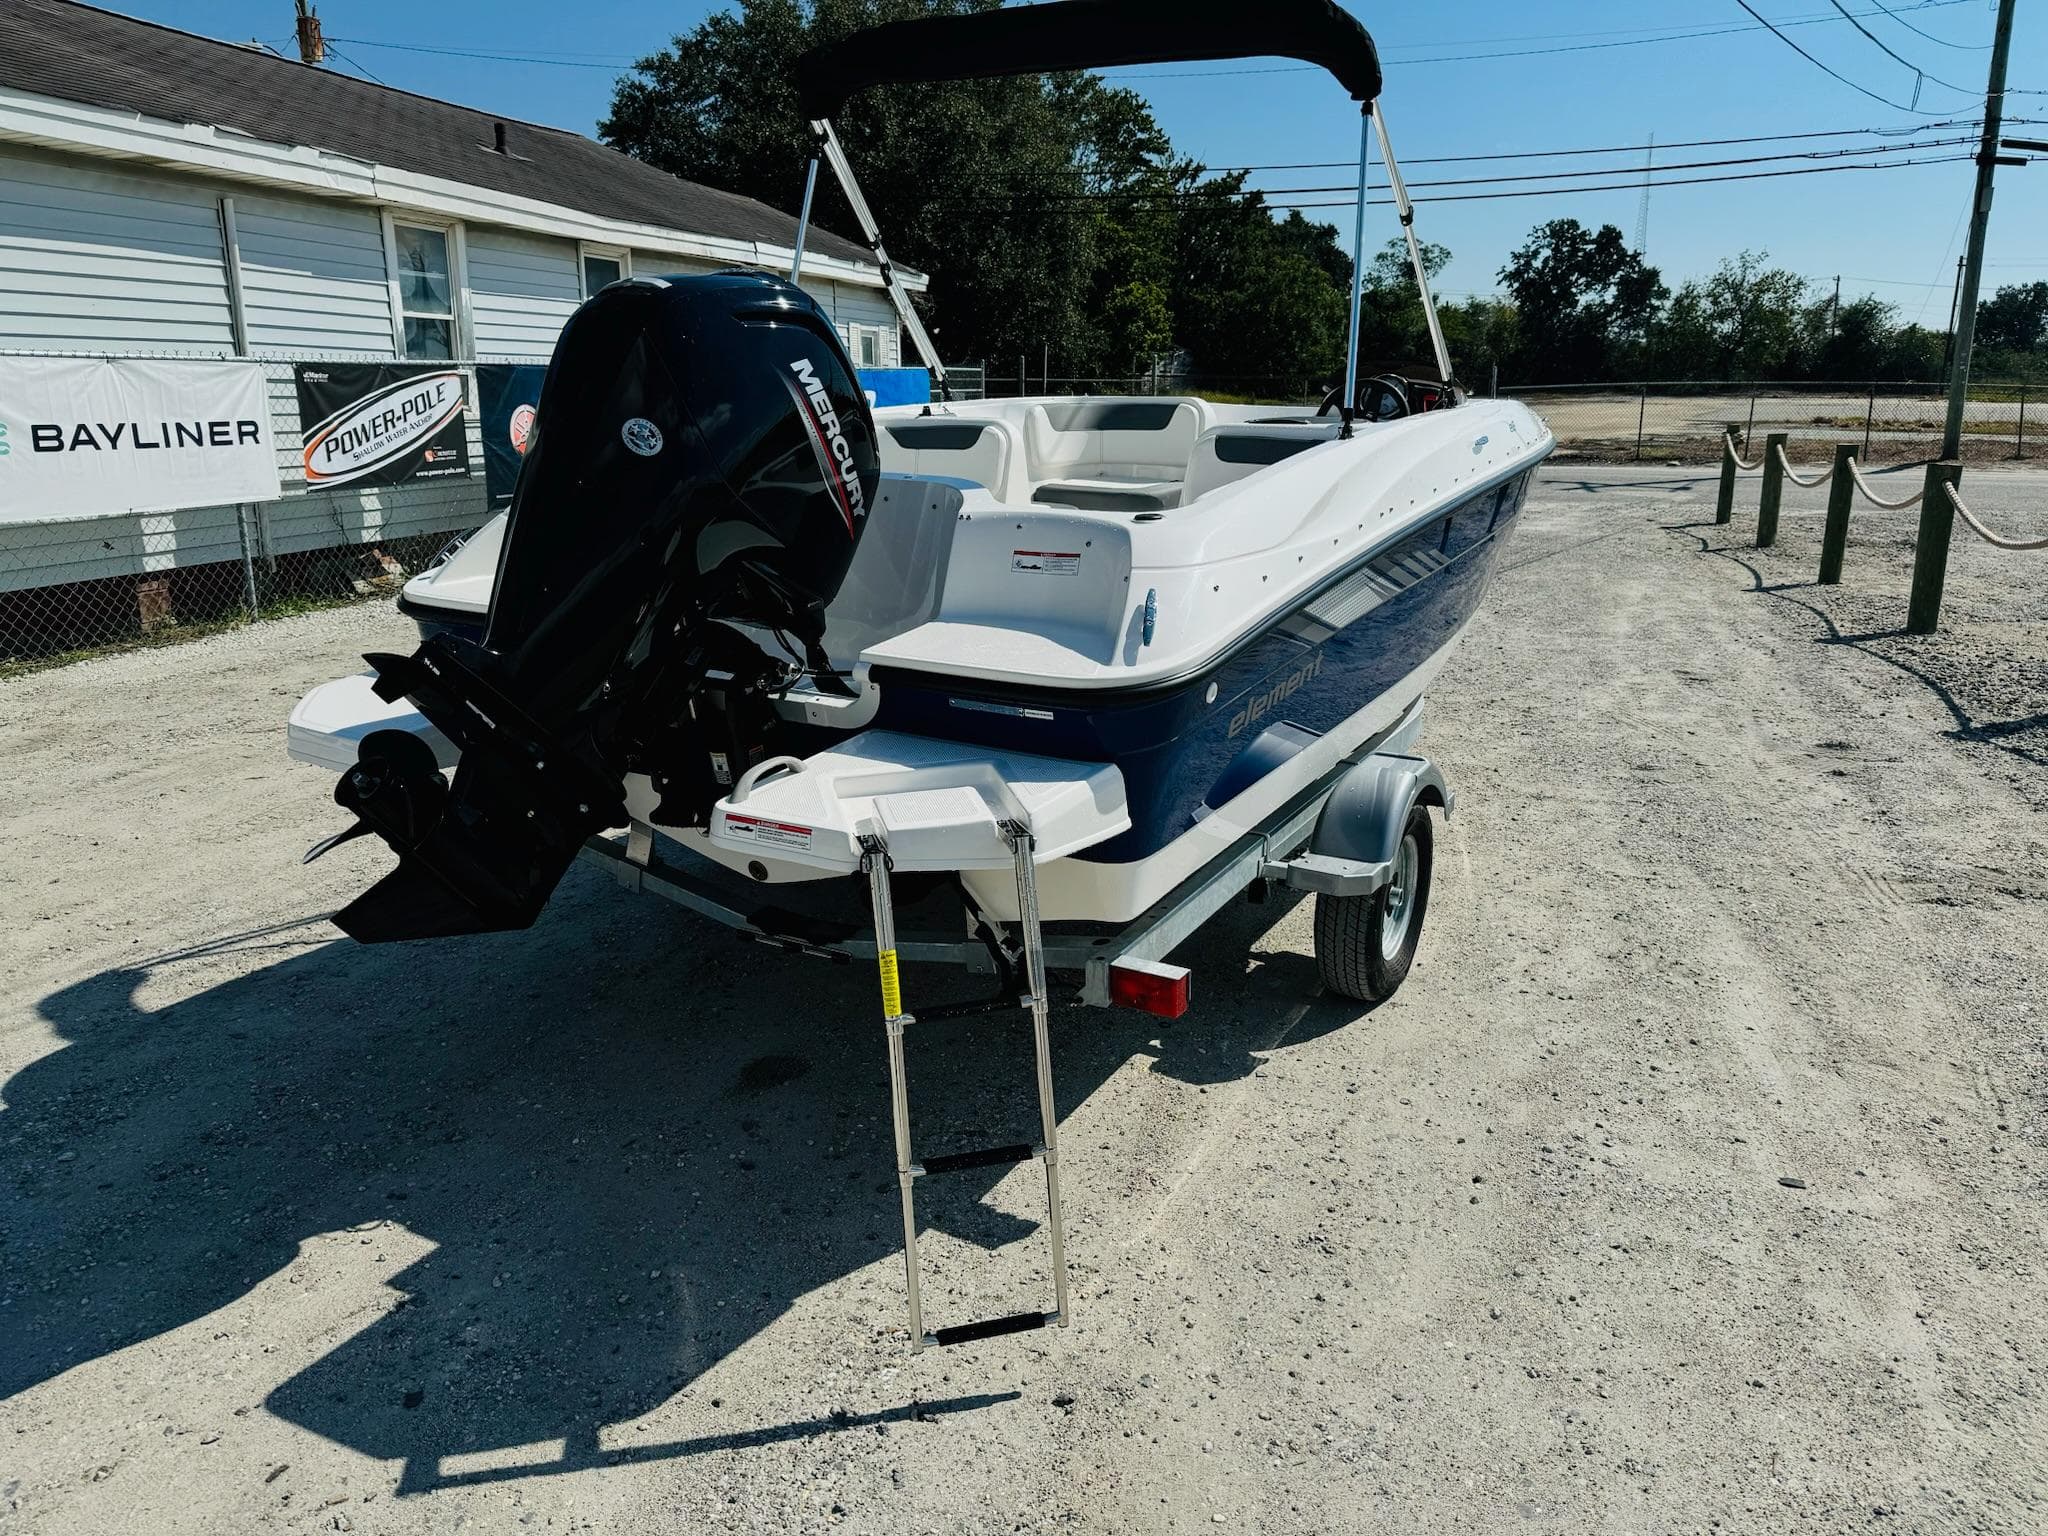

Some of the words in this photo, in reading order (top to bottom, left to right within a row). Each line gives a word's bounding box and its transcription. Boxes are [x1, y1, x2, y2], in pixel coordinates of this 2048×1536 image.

[31, 420, 260, 452] BAYLINER
[325, 382, 446, 463] POWER-POLE
[353, 440, 385, 461] SHALLOW
[385, 427, 409, 443] WATER
[790, 358, 865, 517] MERCURY
[1228, 649, 1324, 738] element
